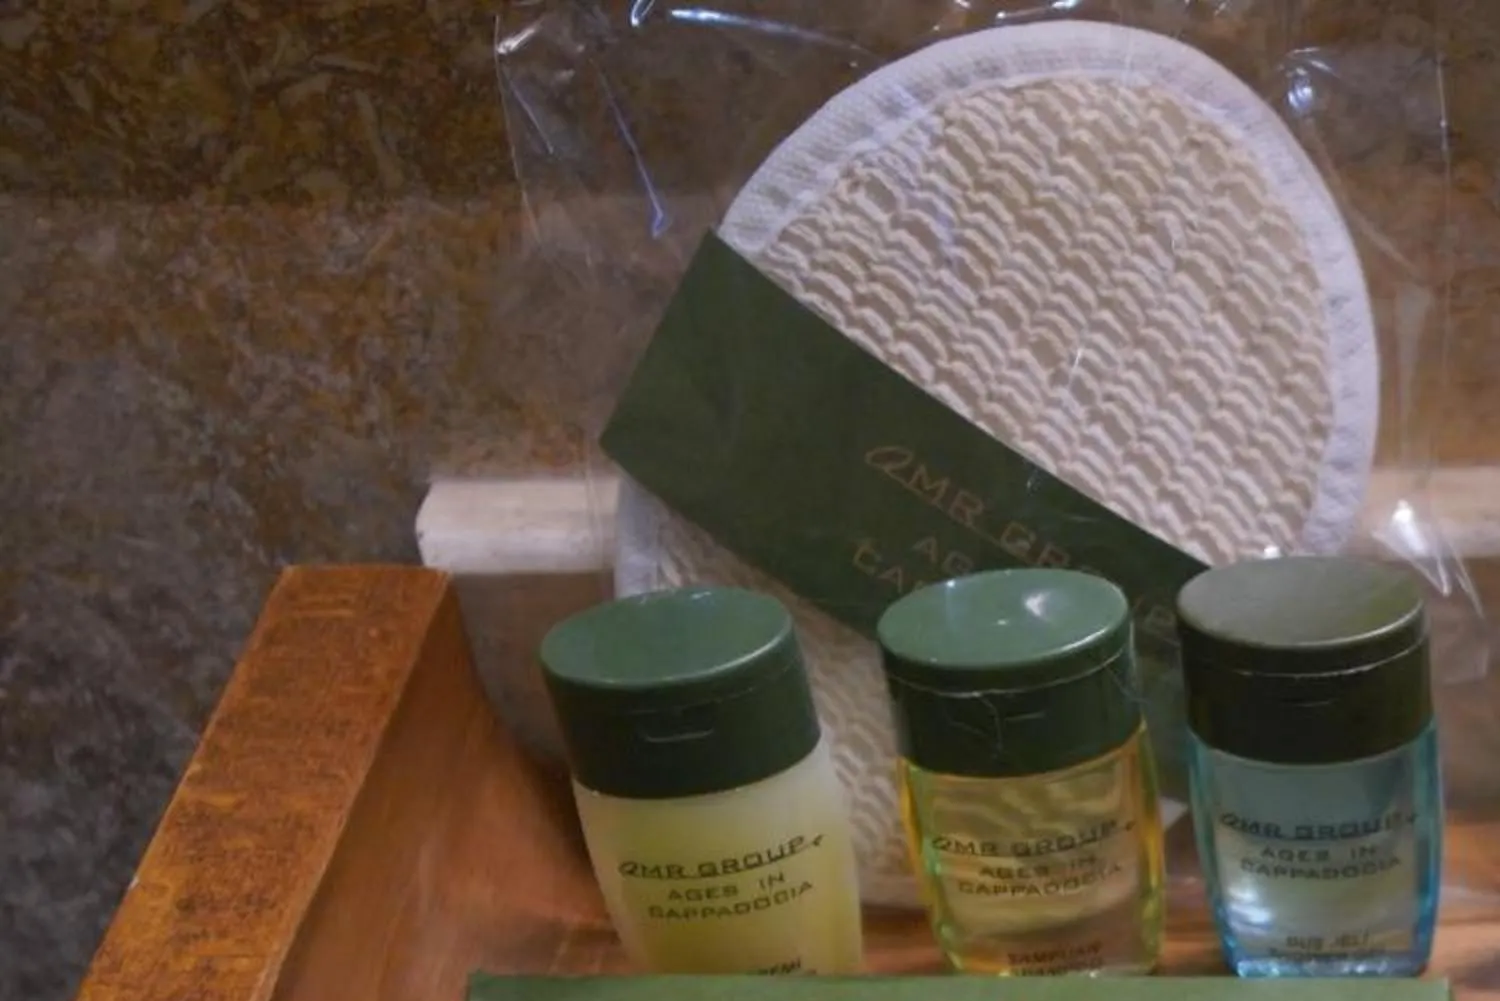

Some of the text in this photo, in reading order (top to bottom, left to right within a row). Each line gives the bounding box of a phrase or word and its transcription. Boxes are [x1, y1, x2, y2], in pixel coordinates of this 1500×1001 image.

[699, 836, 805, 879] GROUP
[668, 871, 786, 901] AGES IN
